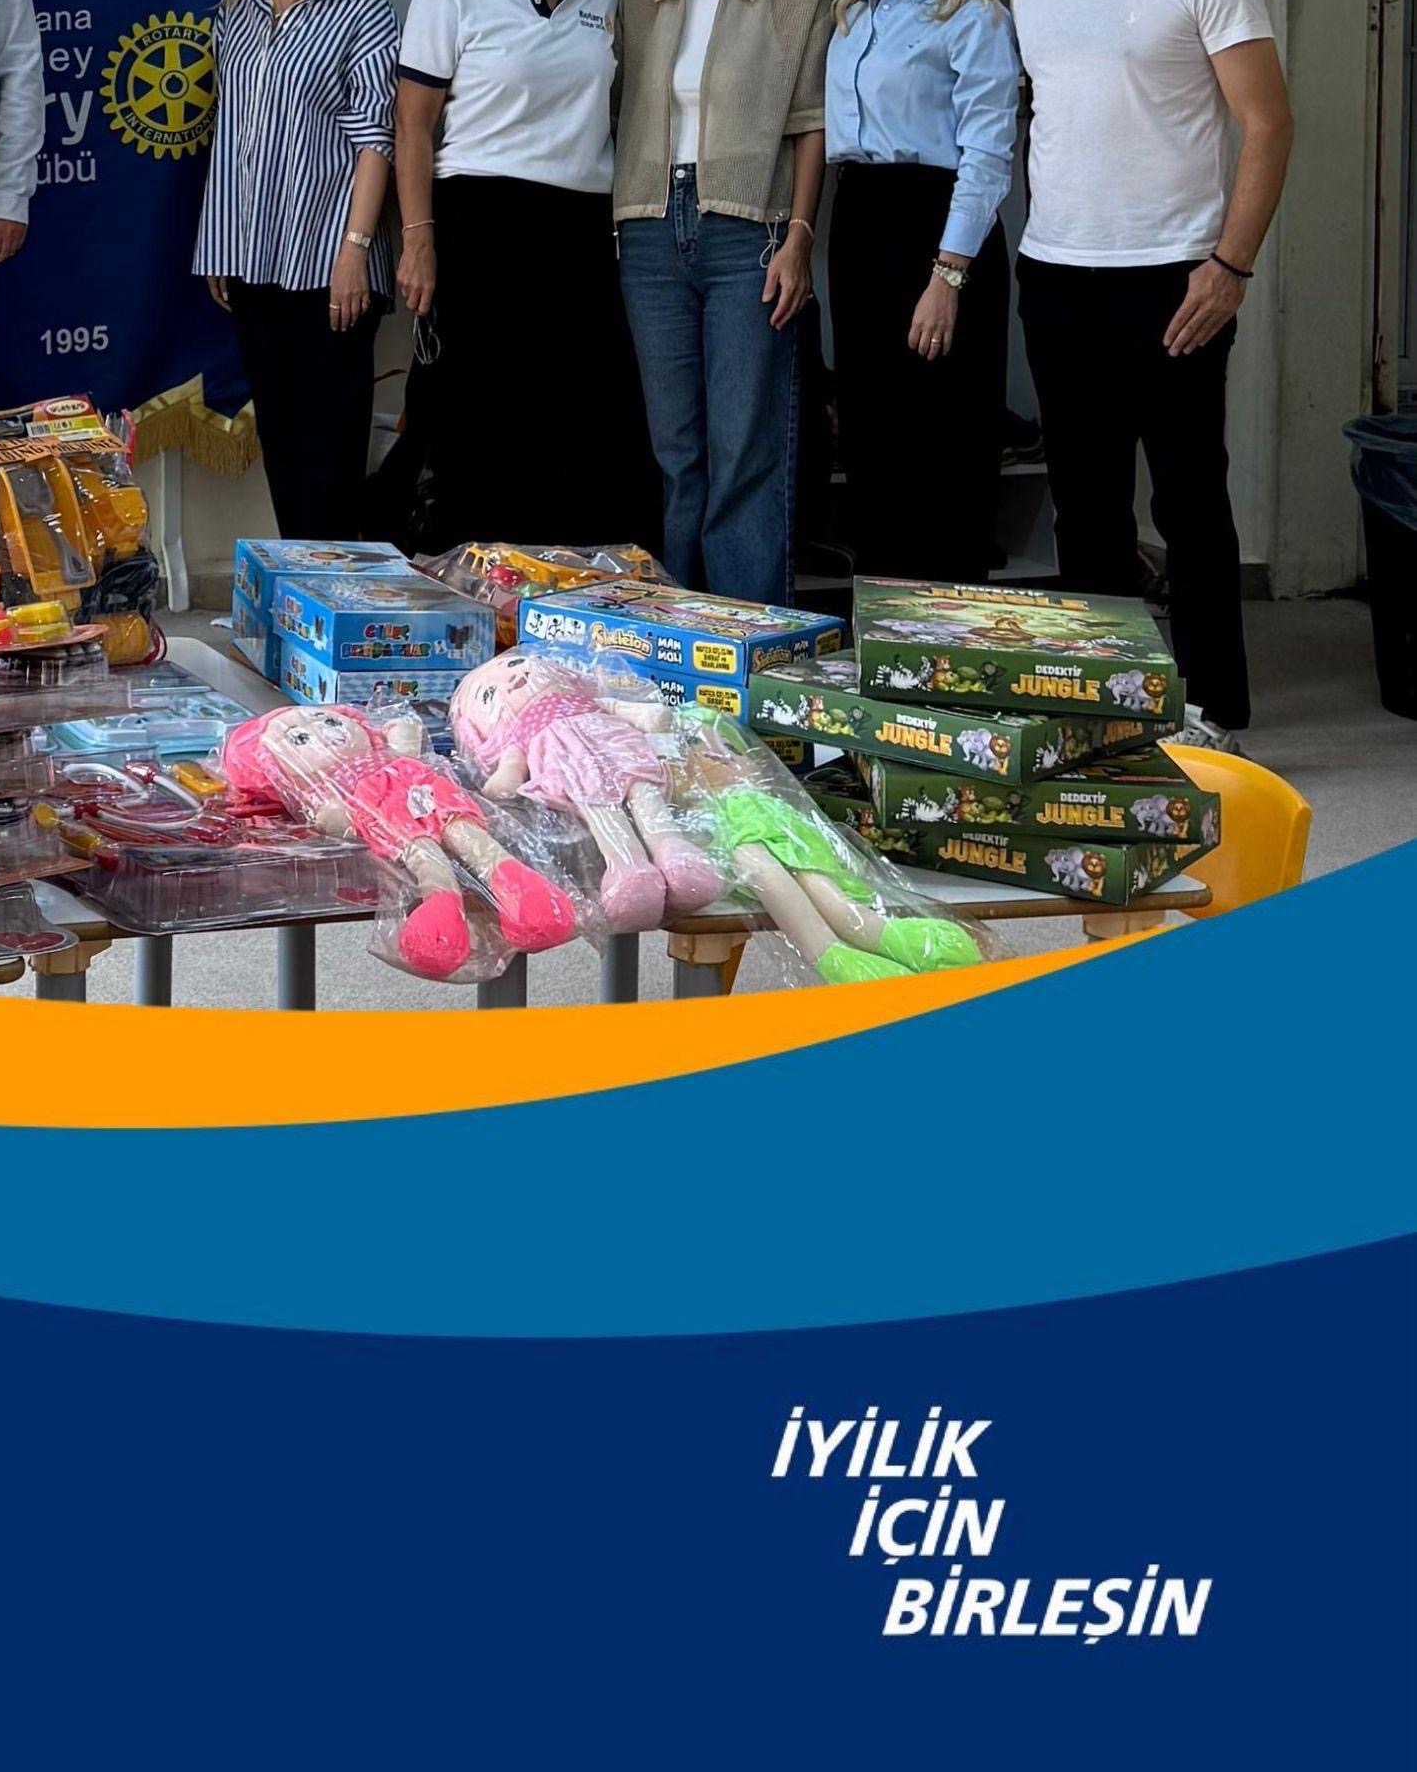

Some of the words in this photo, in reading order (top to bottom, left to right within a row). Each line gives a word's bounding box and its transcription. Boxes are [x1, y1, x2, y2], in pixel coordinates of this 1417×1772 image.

[36, 9, 93, 32] ana
[141, 27, 206, 47] ROTARY
[40, 325, 109, 355] 1995
[1009, 672, 1102, 702] JUNGLE
[875, 720, 953, 757] JUNGLE
[1035, 801, 1126, 829] JUNGLE
[937, 837, 1027, 876] JUNGLE
